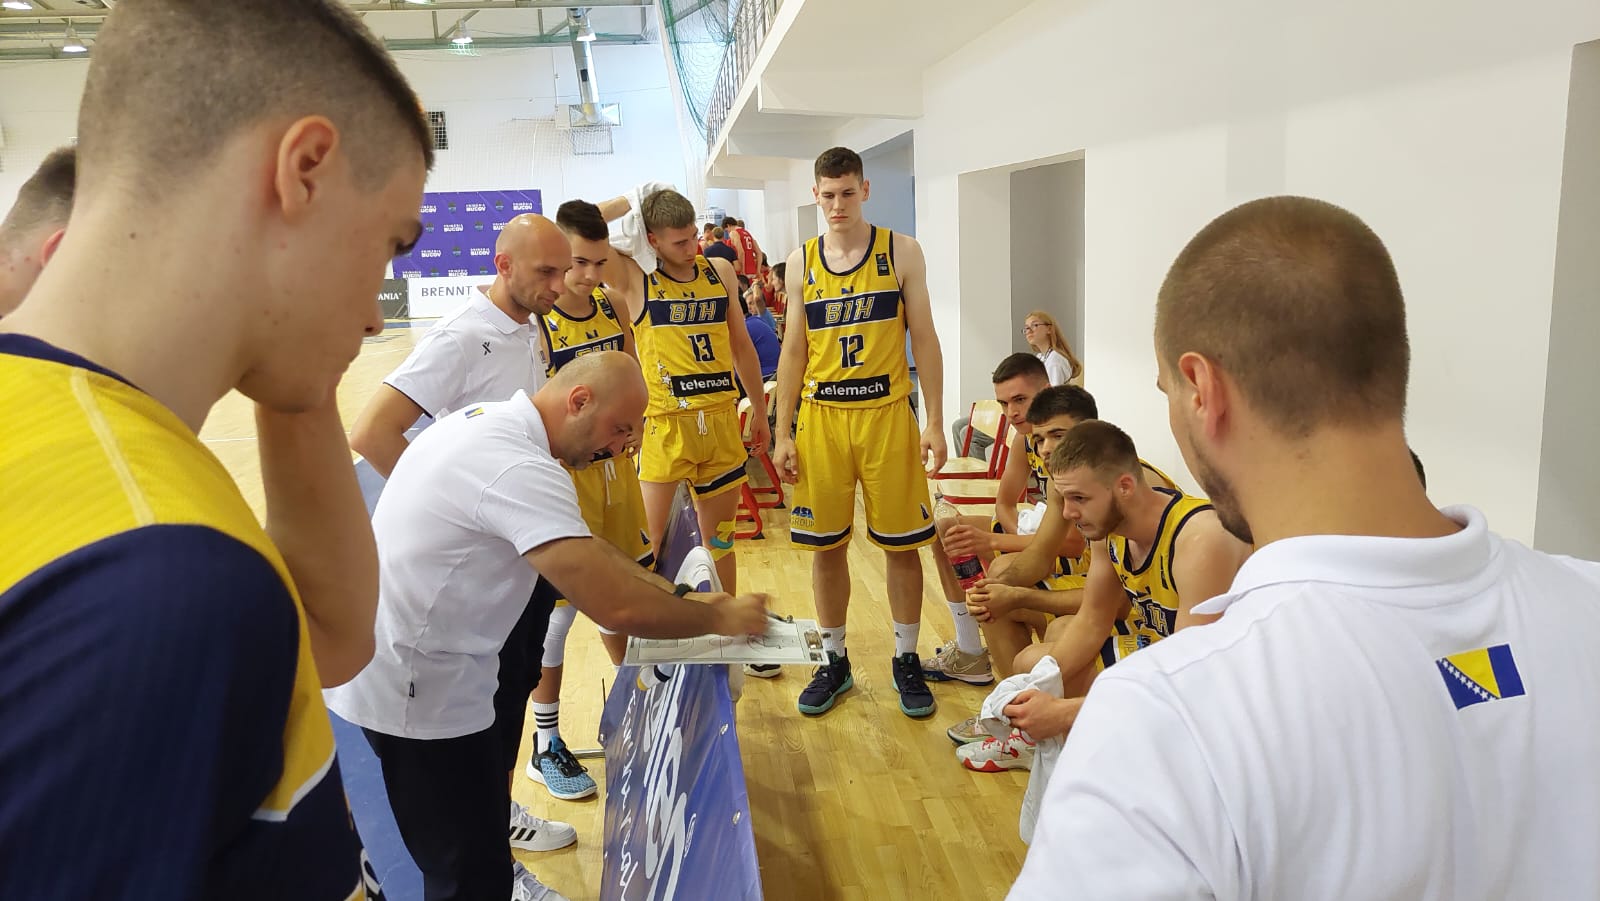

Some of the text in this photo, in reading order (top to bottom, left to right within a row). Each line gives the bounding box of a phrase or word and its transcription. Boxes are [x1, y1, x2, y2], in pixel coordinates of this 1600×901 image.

[421, 285, 473, 297] BRENNT
[688, 333, 716, 362] 13
[838, 334, 865, 369] 12
